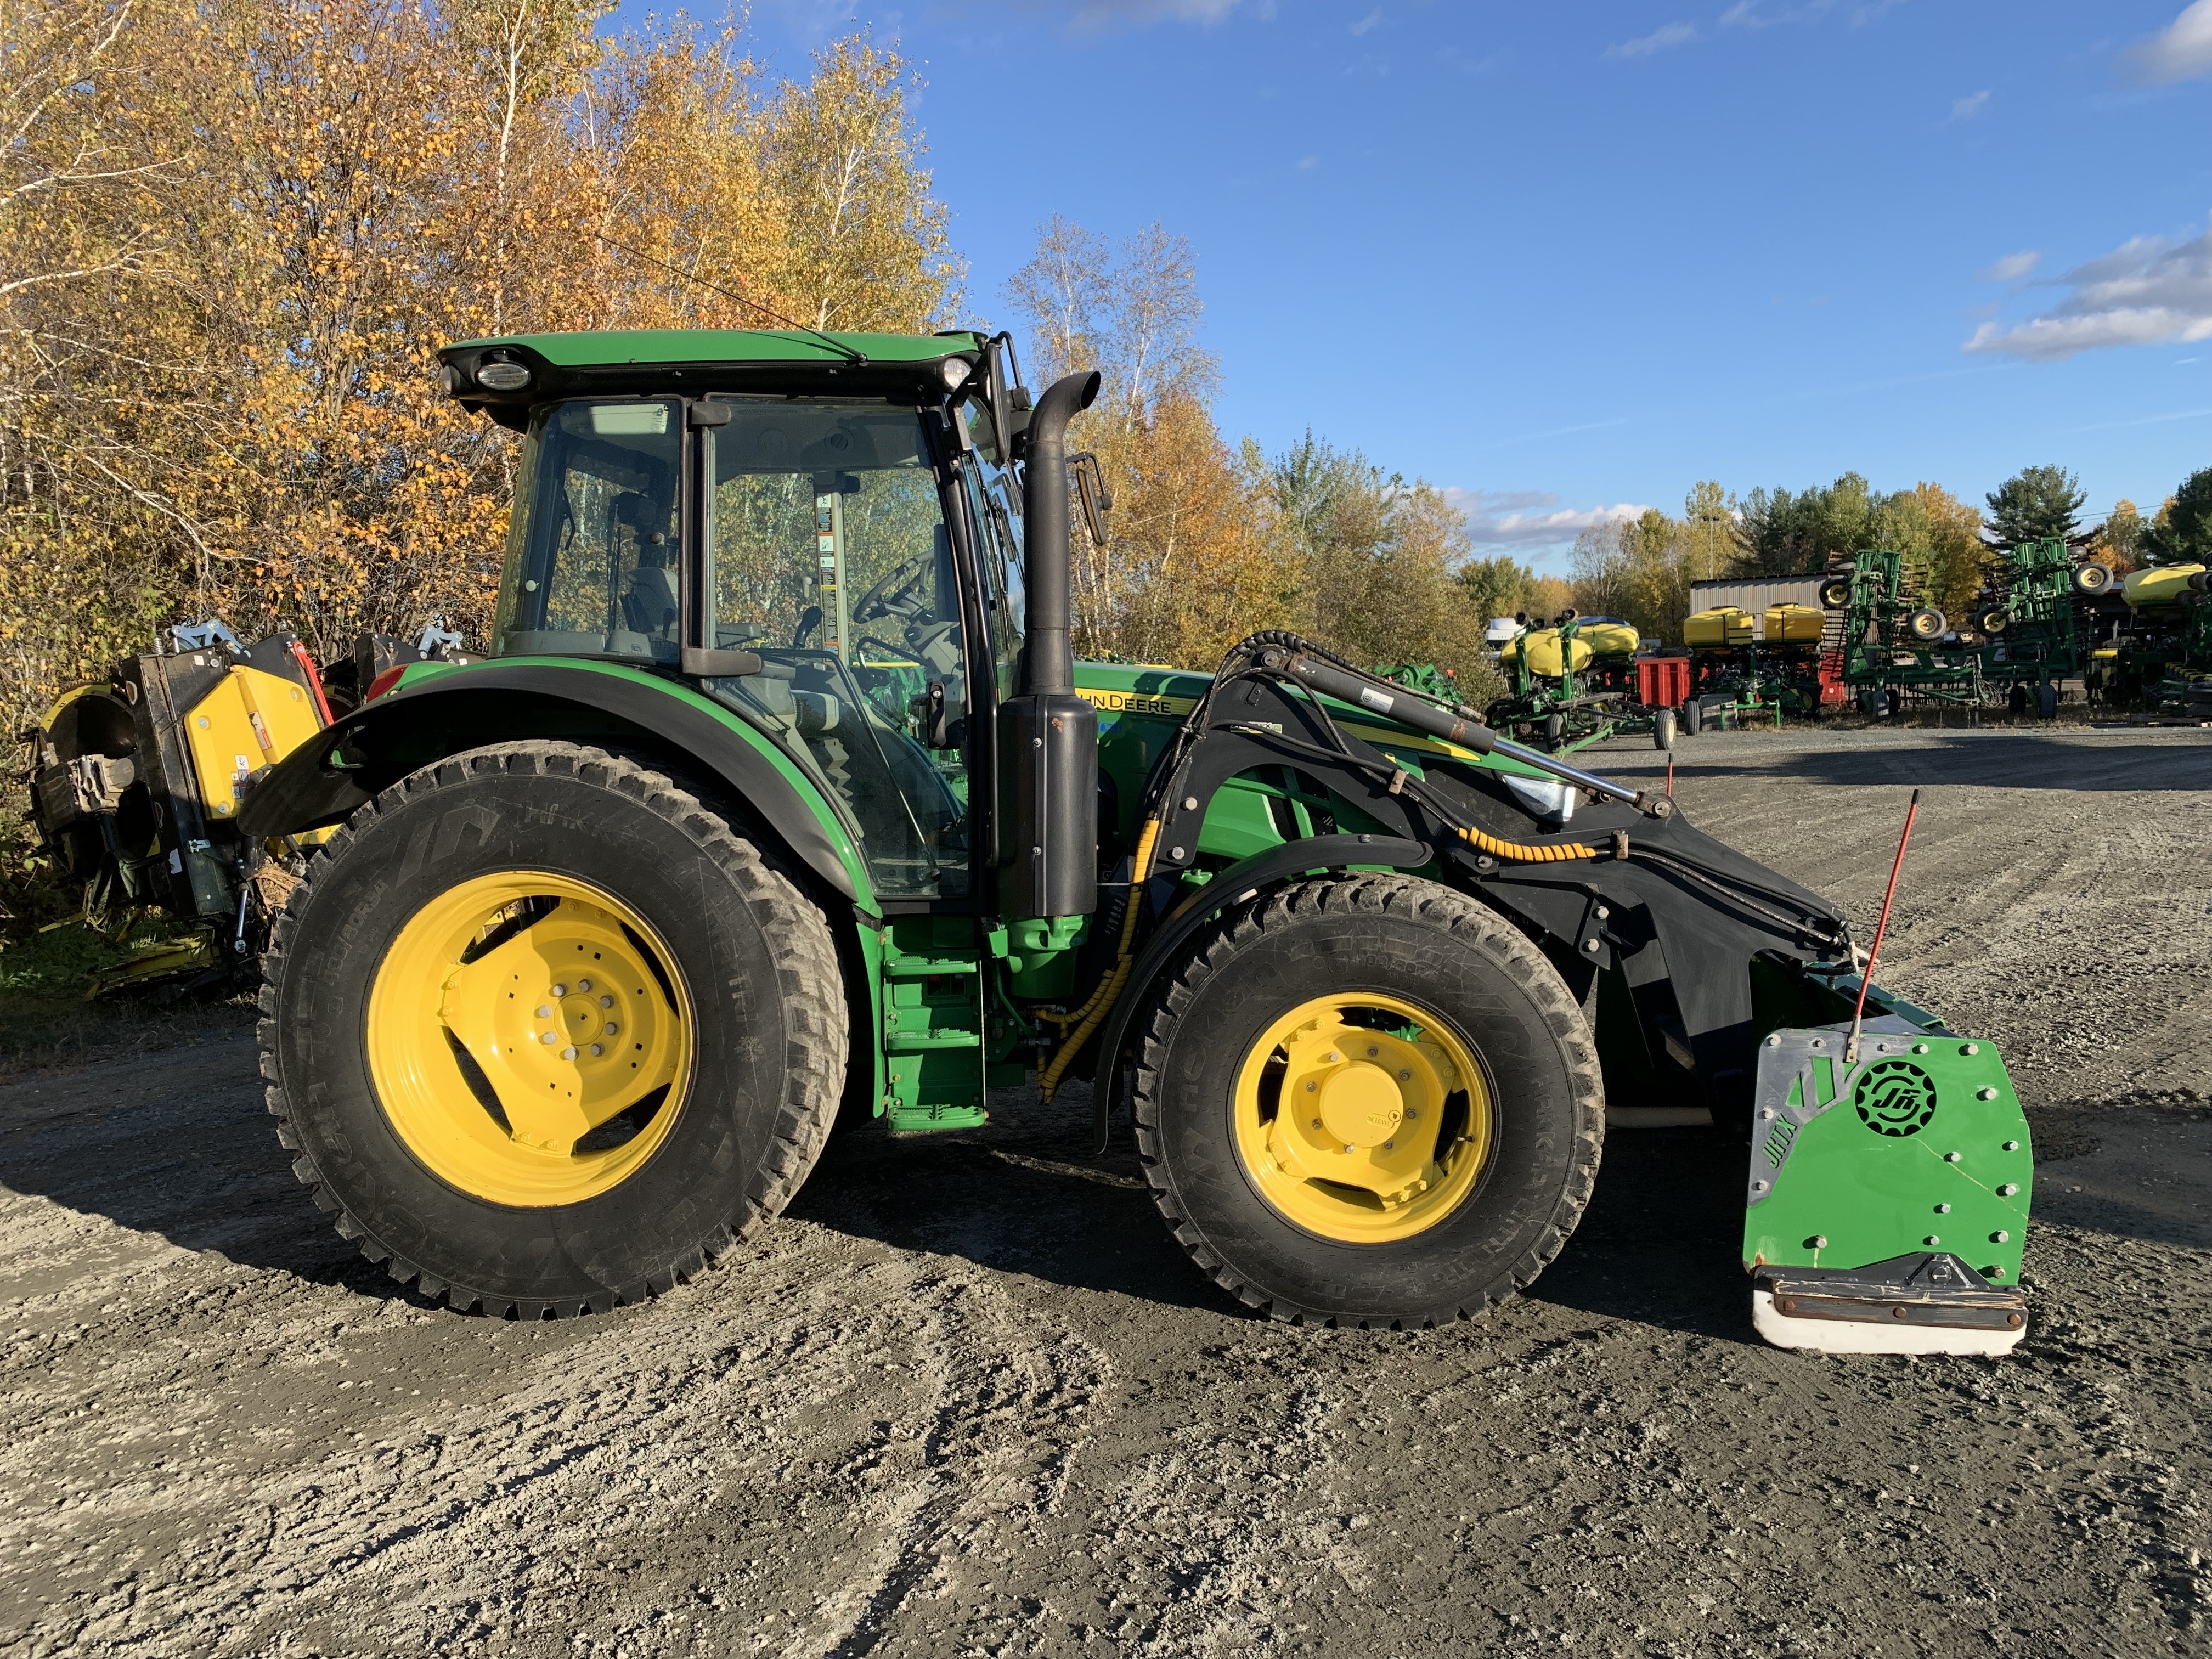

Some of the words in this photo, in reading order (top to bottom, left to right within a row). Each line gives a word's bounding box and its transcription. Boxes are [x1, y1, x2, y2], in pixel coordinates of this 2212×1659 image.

[1081, 694, 1105, 707] HN
[1110, 695, 1172, 713] DEERE
[1871, 1088, 1921, 1110] JR
[1763, 1113, 1797, 1169] JRTX
